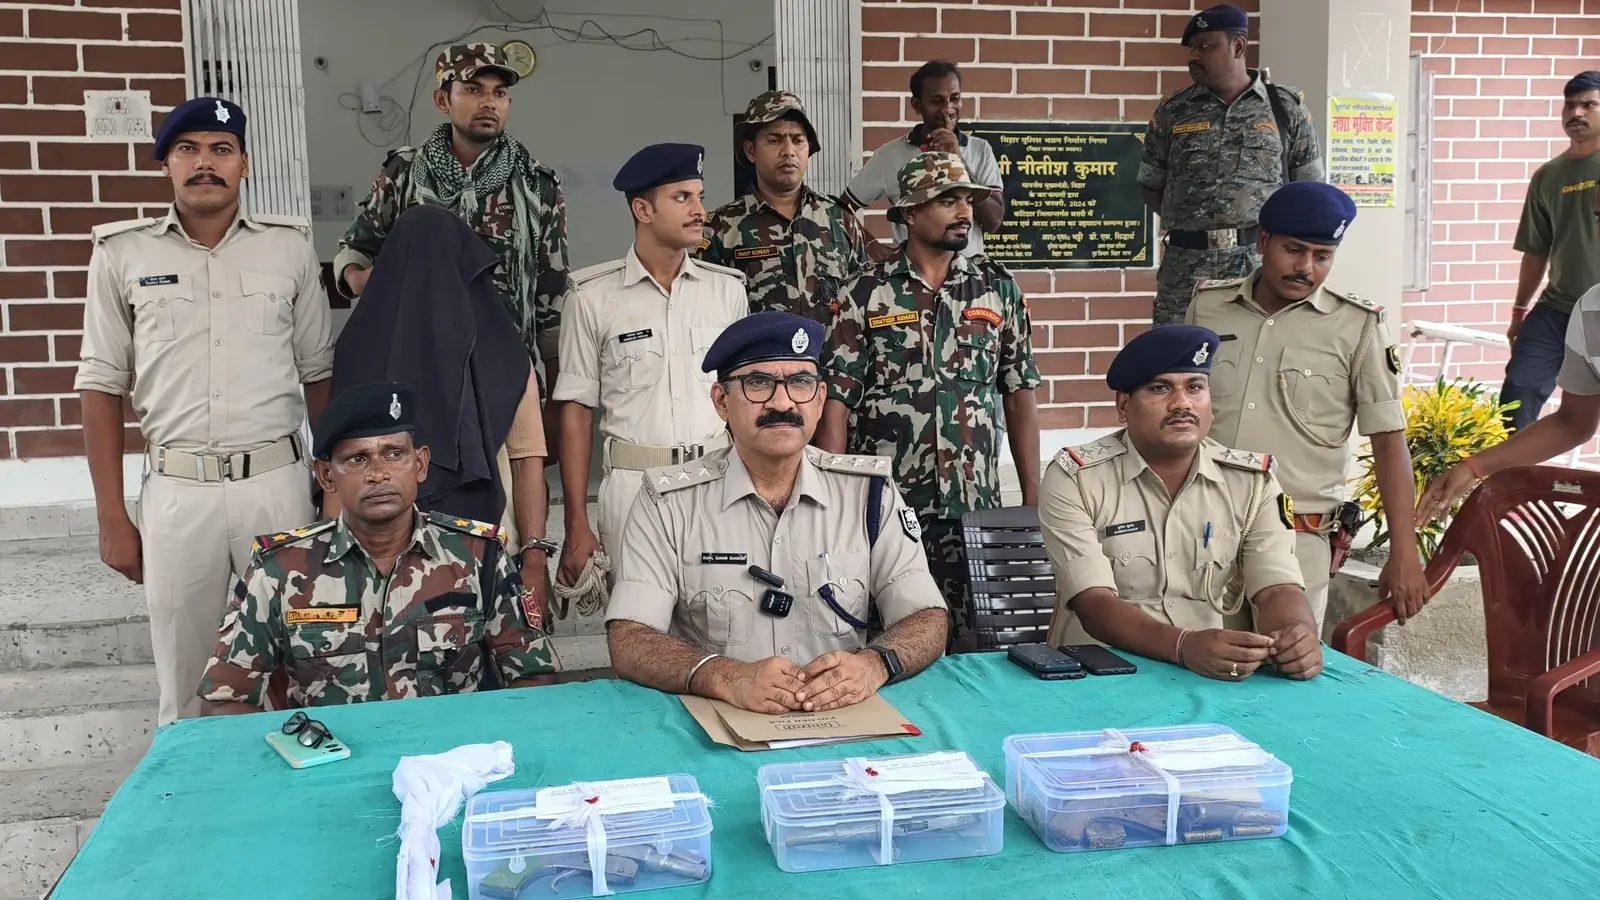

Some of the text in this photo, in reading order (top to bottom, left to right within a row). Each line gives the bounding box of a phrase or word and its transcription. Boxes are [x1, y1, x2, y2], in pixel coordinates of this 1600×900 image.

[1333, 112, 1393, 136] नशा मुक्ति केन्द्र
[1022, 136, 1041, 145] पुलिस
[1088, 136, 1107, 144] निगम
[1016, 154, 1068, 175] नीतीश
[1073, 162, 1118, 179] कुमार
[1002, 234, 1019, 242] कुमार
[967, 309, 1000, 323] COMMANDO
